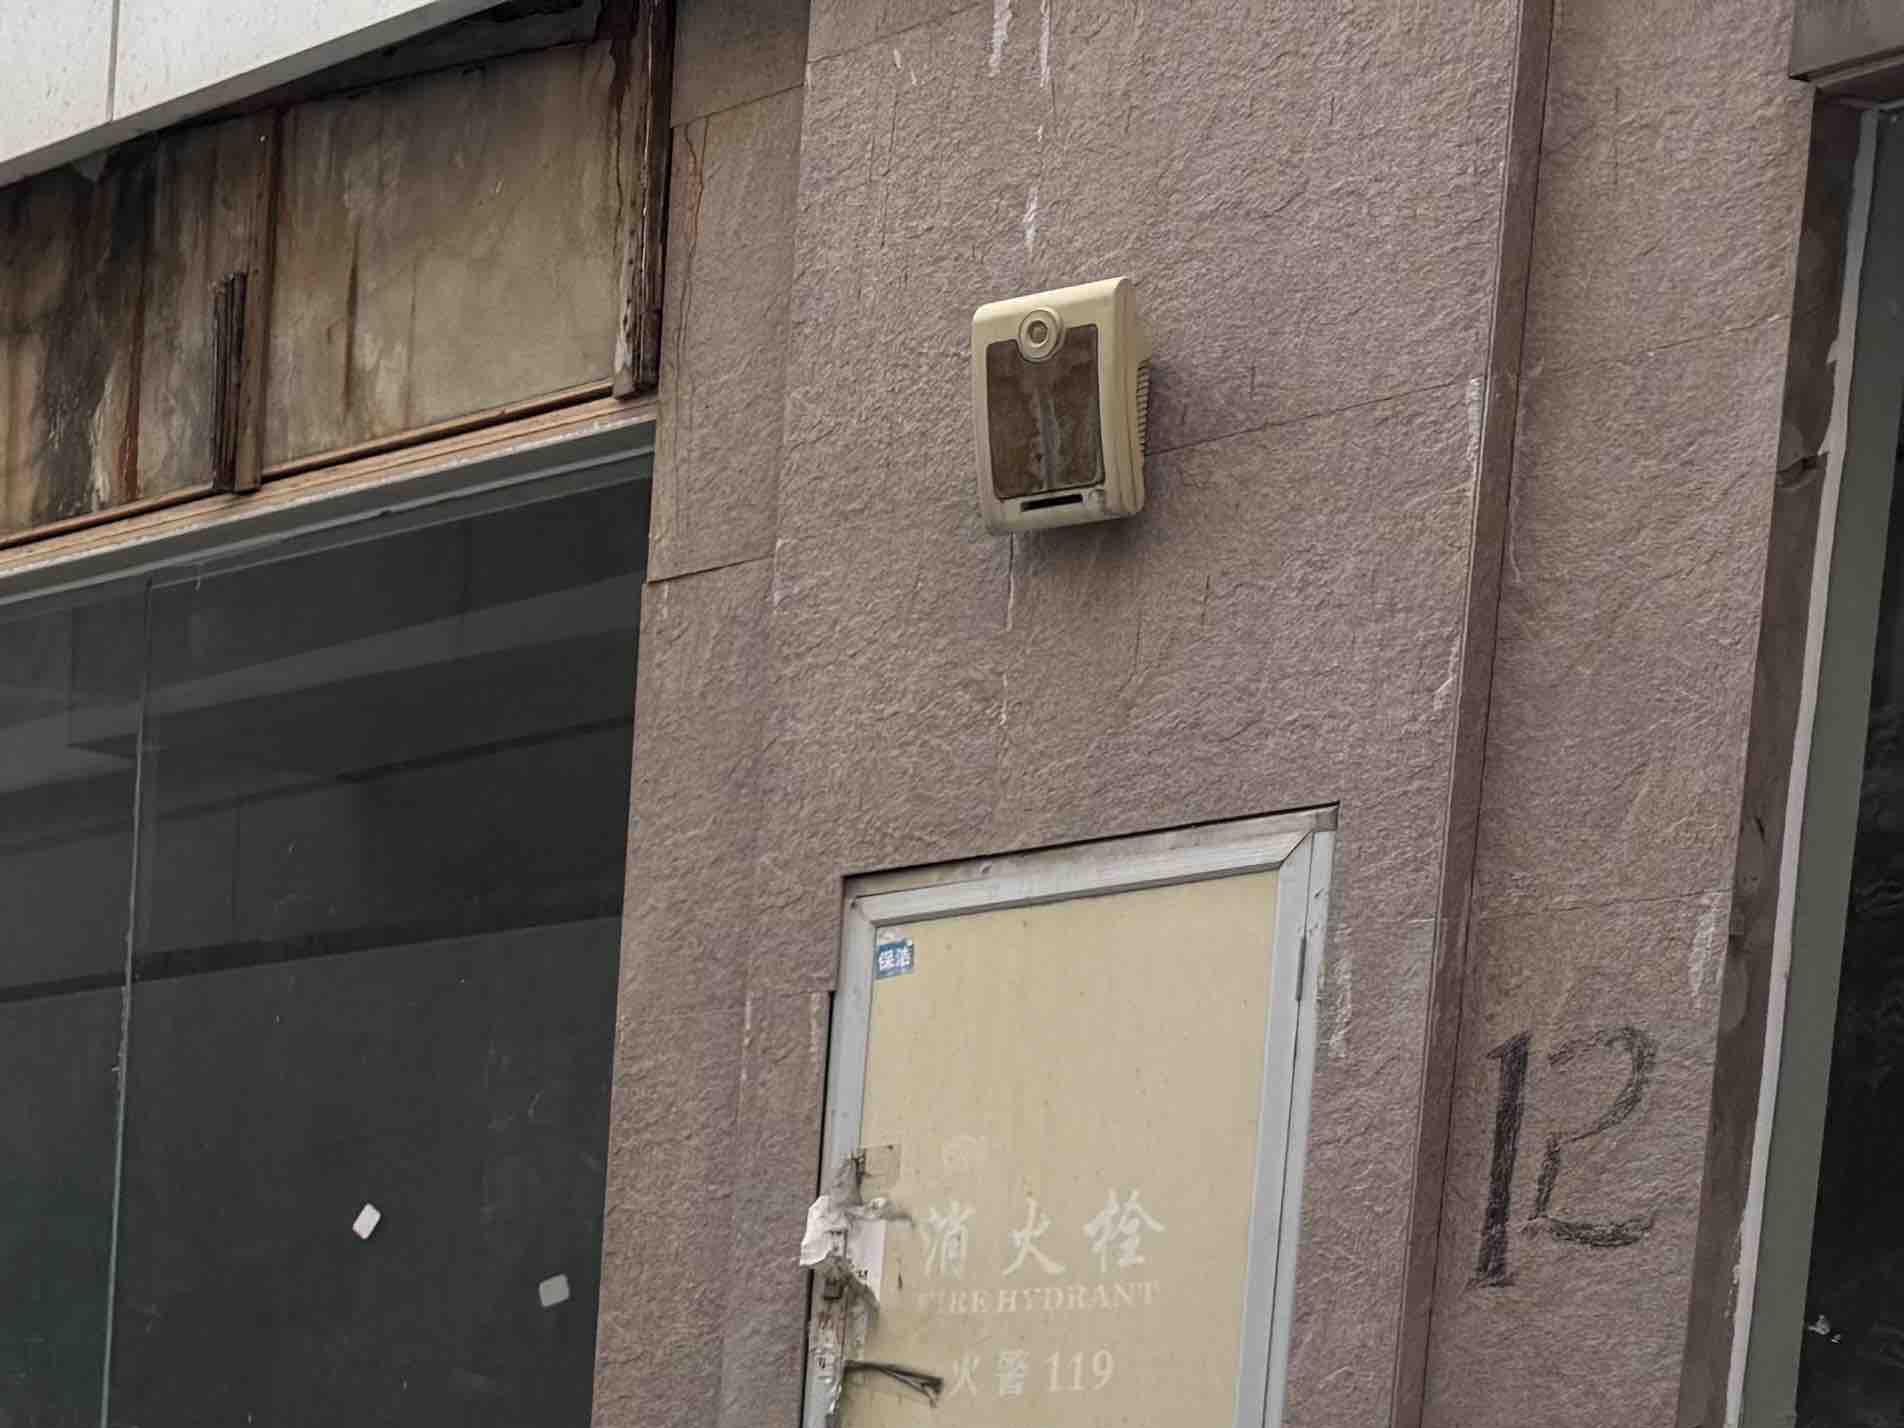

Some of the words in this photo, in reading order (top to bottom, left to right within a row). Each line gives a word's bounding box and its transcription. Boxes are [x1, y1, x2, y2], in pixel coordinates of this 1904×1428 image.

[1467, 1026, 1657, 1288] 12
[919, 1186, 1166, 1280] 消火栓
[997, 1280, 1160, 1313] HYDRANT
[946, 1347, 1030, 1400] 火警
[1043, 1347, 1115, 1394] 119
